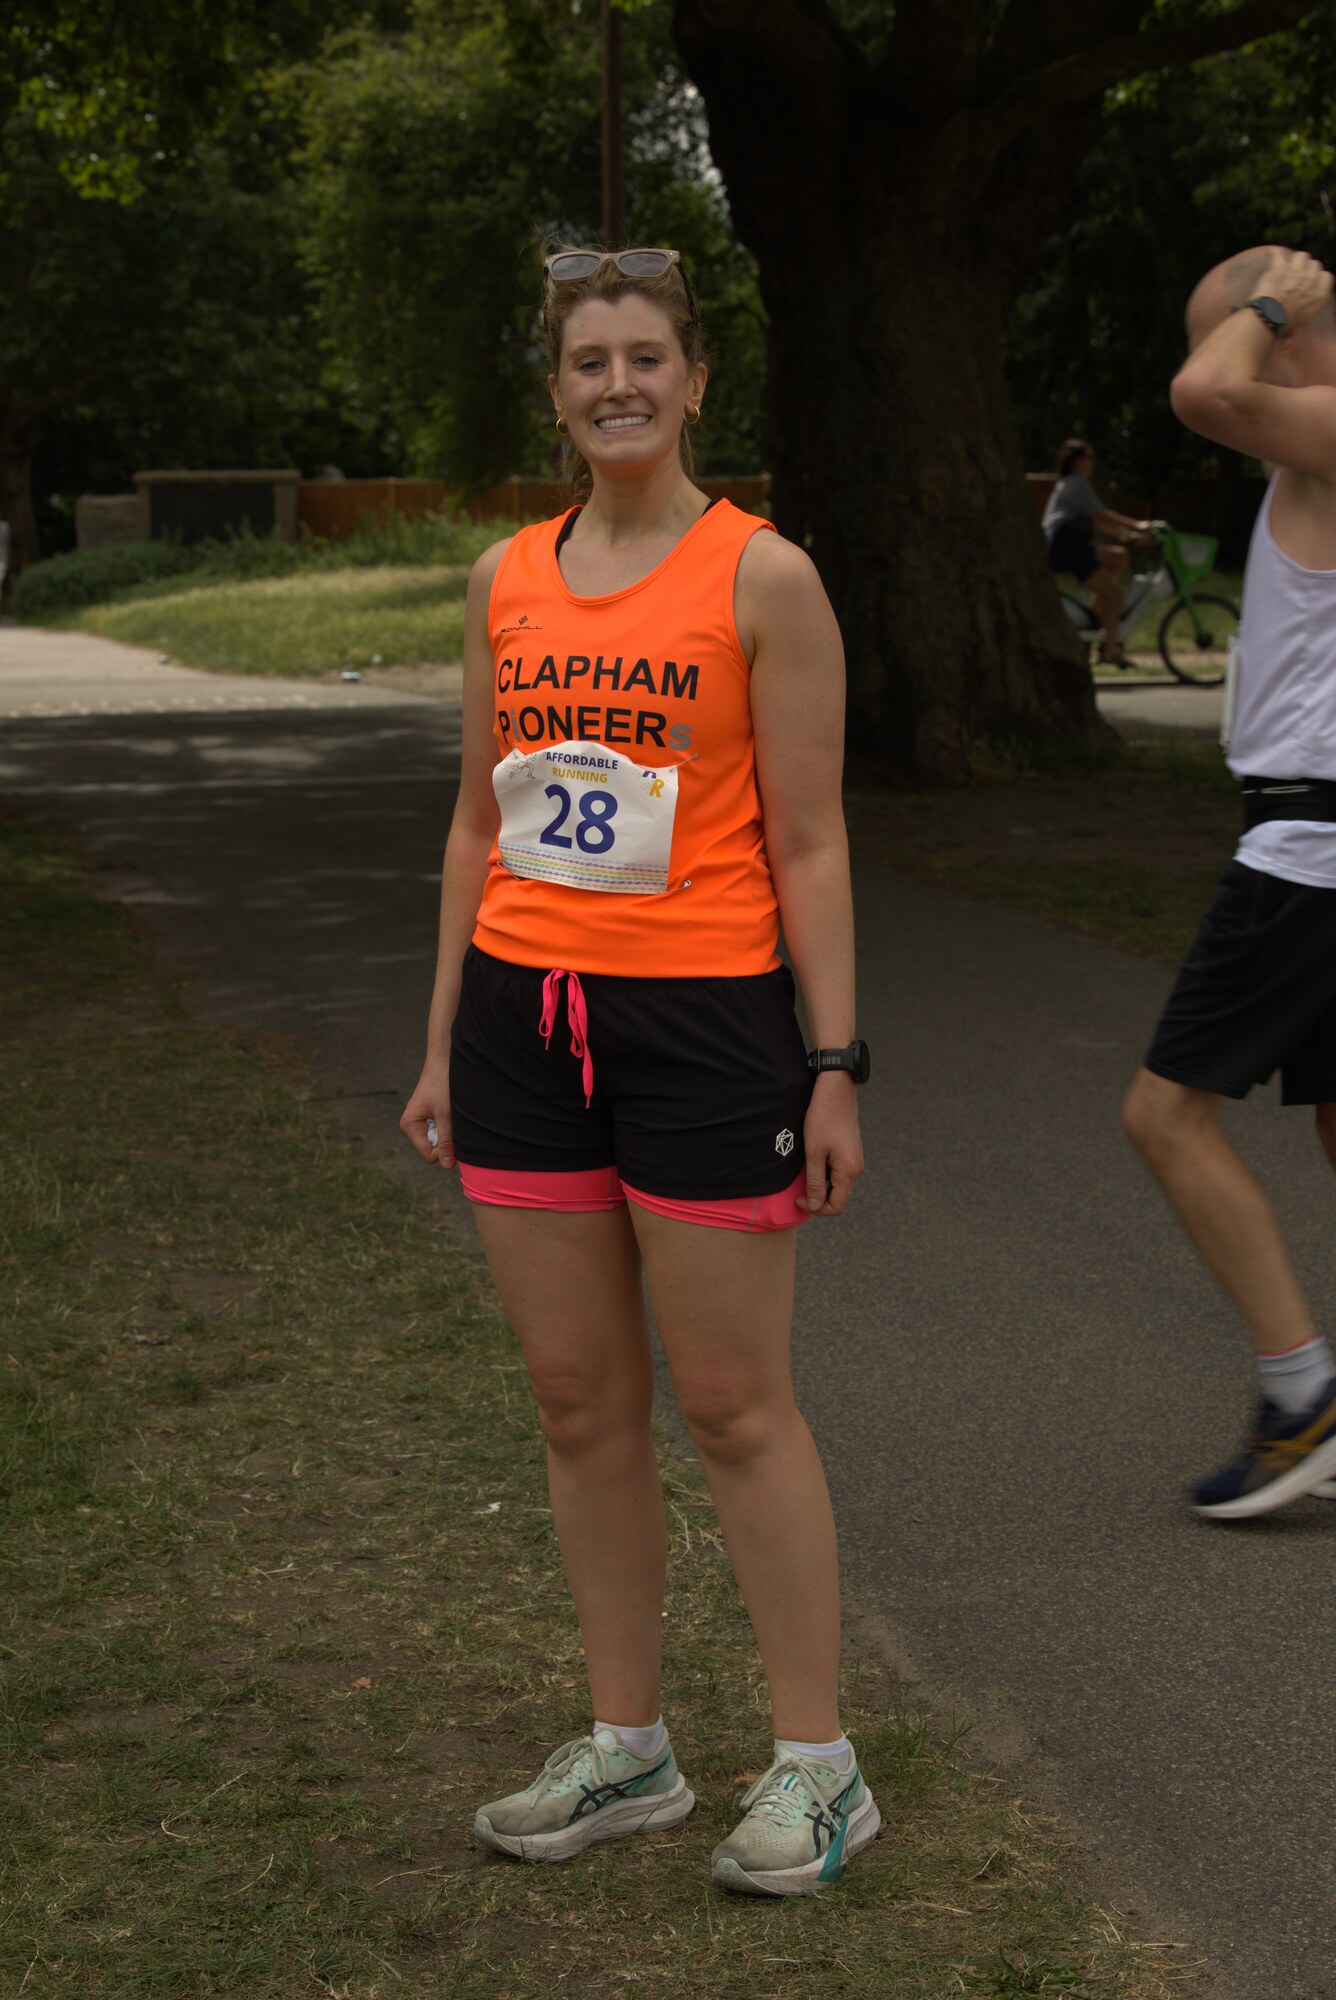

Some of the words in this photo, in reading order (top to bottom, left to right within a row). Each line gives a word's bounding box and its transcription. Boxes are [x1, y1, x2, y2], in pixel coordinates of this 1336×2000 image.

[498, 655, 700, 701] CLAPHAM
[546, 751, 619, 770] AFFORDABLE
[552, 766, 608, 784] RUNNING
[539, 783, 619, 855] 28
